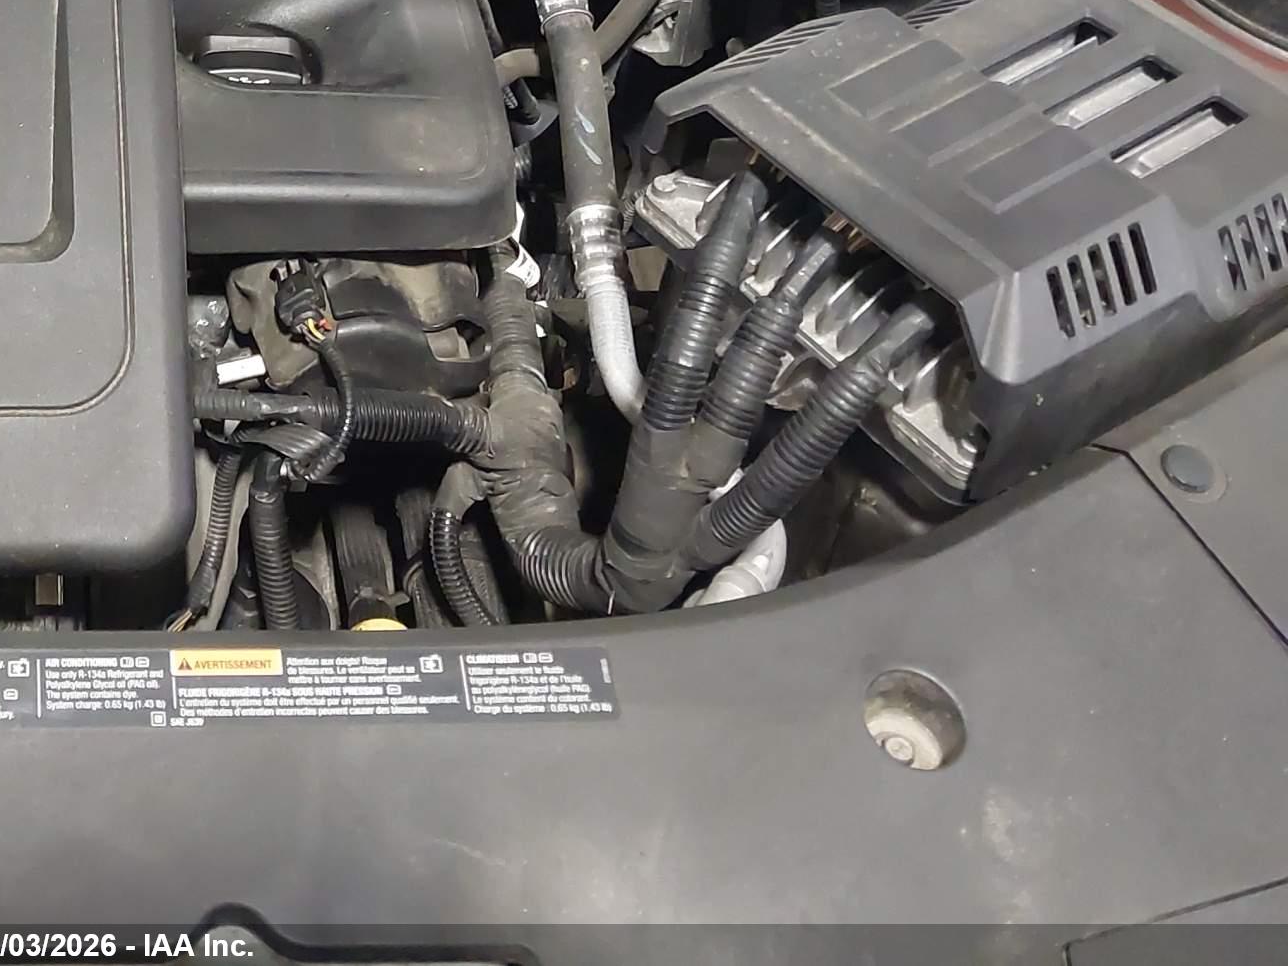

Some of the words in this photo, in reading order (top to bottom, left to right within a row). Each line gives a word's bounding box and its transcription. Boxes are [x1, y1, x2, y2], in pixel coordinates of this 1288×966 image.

[45, 658, 59, 667] AIR
[61, 658, 117, 667] CONDITIONING
[194, 660, 272, 669] AVERTISSEMENT
[45, 670, 59, 679] Use
[61, 670, 77, 680] only
[78, 670, 106, 679] R-134a
[107, 670, 148, 679] Refrigerant
[149, 669, 164, 678] and
[93, 681, 115, 689] Glycol
[117, 680, 126, 688] oil
[127, 680, 145, 689] (PAG
[510, 676, 539, 684] R-134a
[539, 676, 548, 684] et
[549, 676, 559, 684] de
[47, 691, 60, 699] The
[62, 691, 88, 700] system
[90, 691, 121, 699] contains
[122, 690, 138, 700] dye.
[472, 696, 483, 704] Le
[548, 695, 558, 703] du
[46, 701, 74, 710] System
[104, 701, 122, 709] 0.65
[123, 701, 133, 710] kg
[155, 700, 166, 709] lb)
[474, 705, 501, 715] Charge
[502, 705, 513, 713] du
[569, 704, 580, 714] kg
[180, 709, 195, 717] Des
